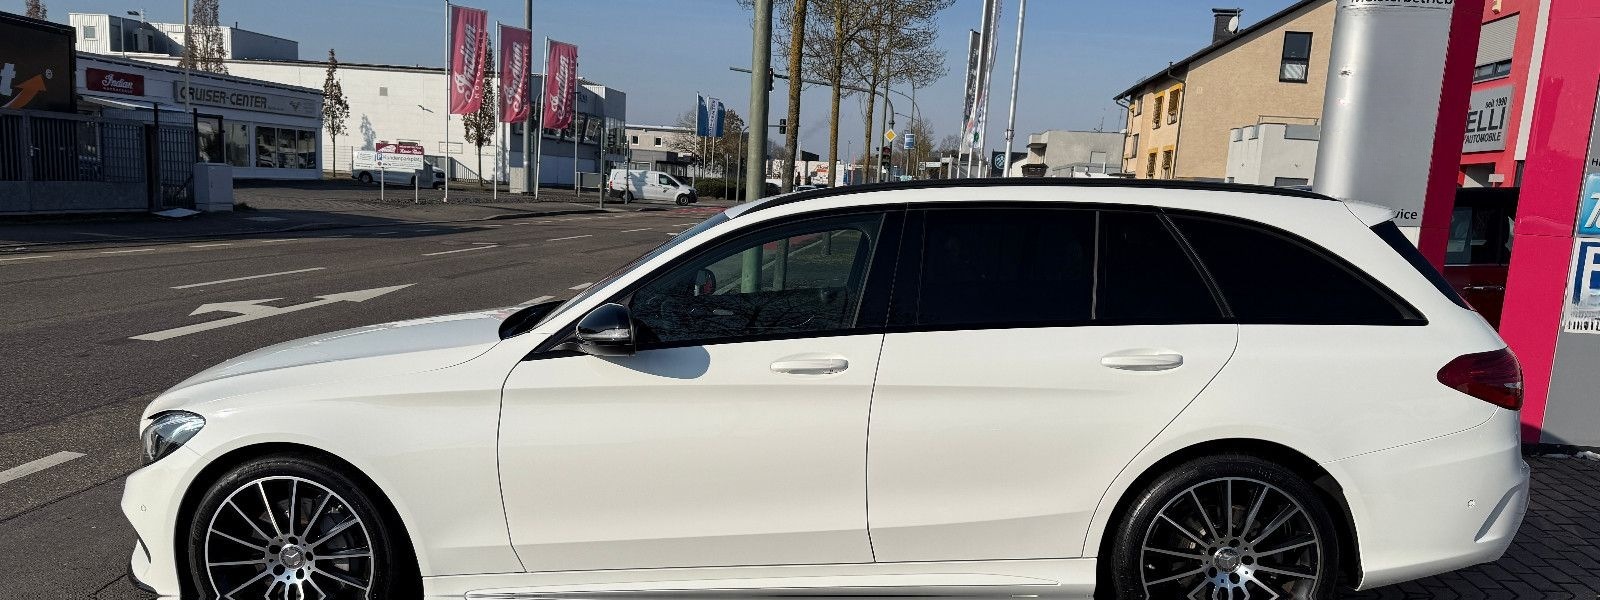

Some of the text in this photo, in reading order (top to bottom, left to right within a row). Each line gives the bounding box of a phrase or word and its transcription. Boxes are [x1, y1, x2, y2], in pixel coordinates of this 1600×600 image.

[102, 74, 133, 89] Indian
[454, 24, 477, 103] Indian
[503, 41, 523, 113] Indian
[549, 54, 569, 120] Indian
[180, 86, 267, 109] CRUISER-CENTER
